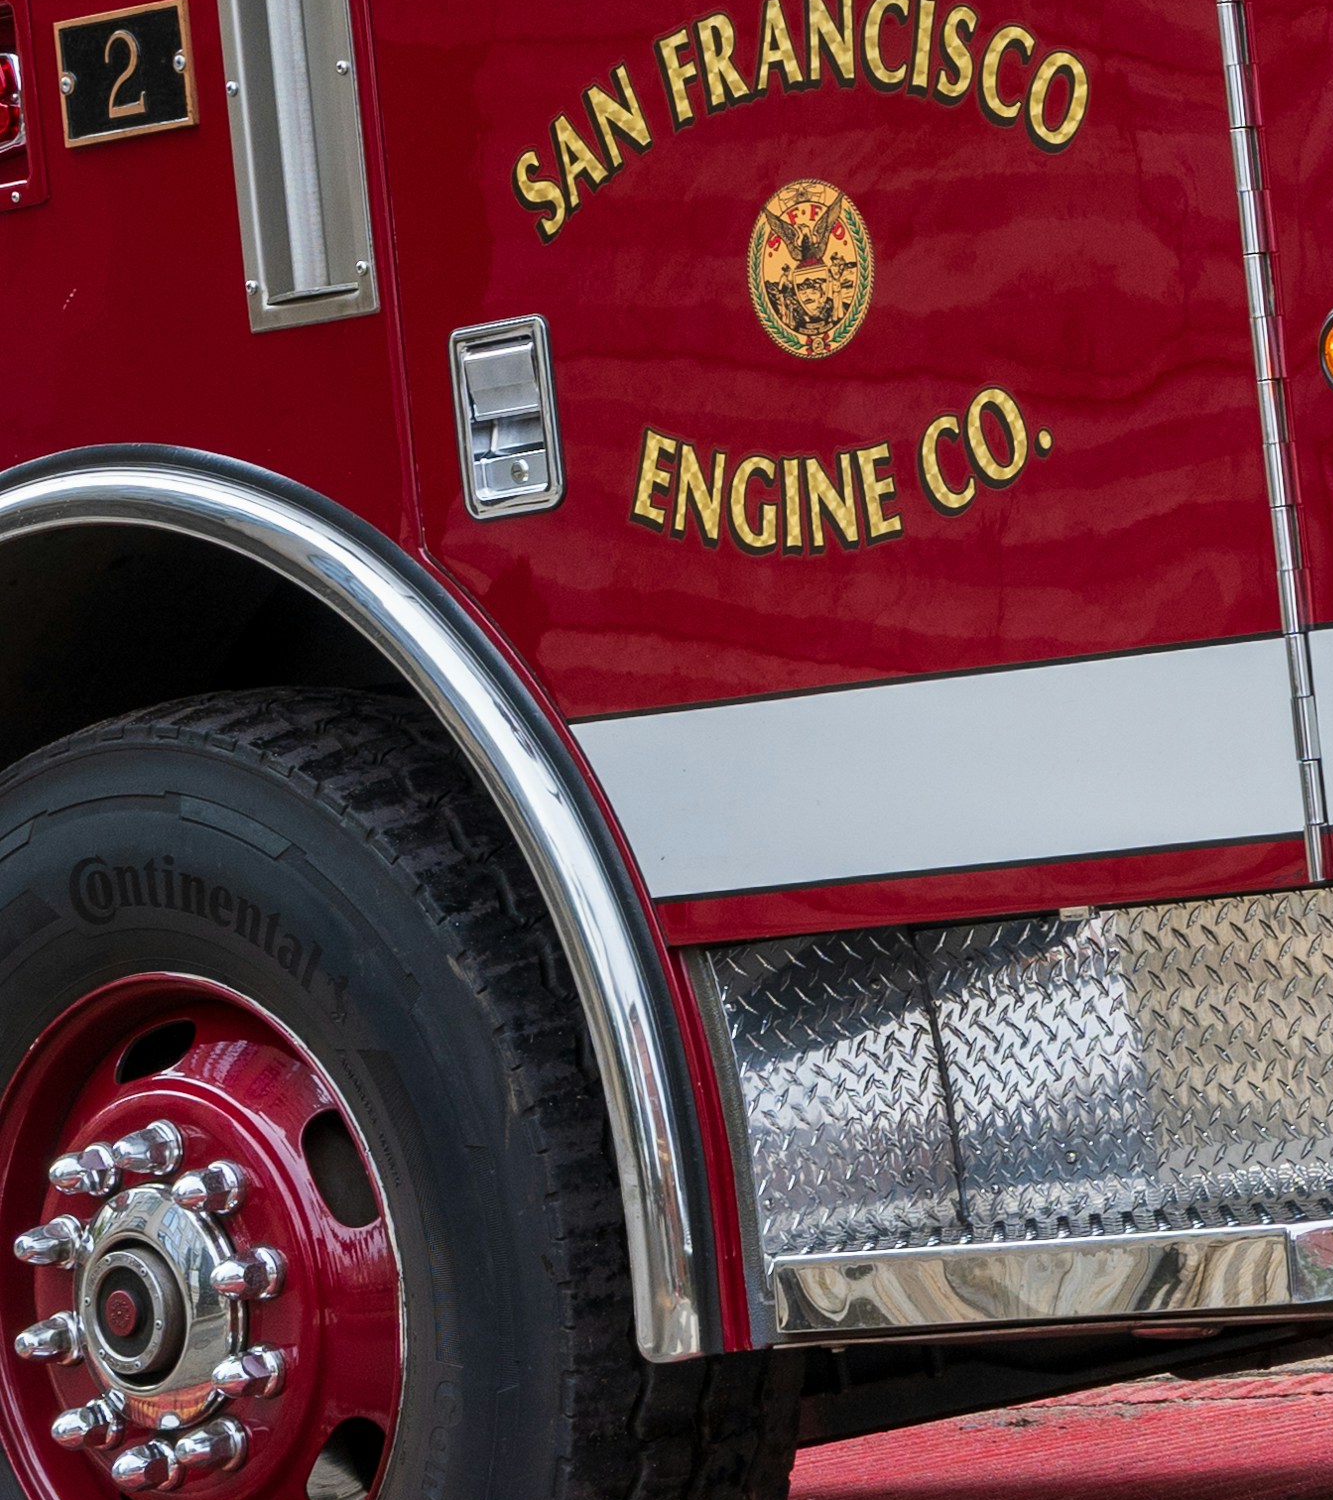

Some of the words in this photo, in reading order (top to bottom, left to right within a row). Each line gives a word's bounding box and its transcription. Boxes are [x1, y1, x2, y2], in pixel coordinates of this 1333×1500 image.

[104, 29, 146, 119] 2
[512, 64, 654, 243] SAN
[629, 427, 902, 556] ENGINE
[917, 385, 1054, 518] CO.
[68, 853, 325, 997] Continental
